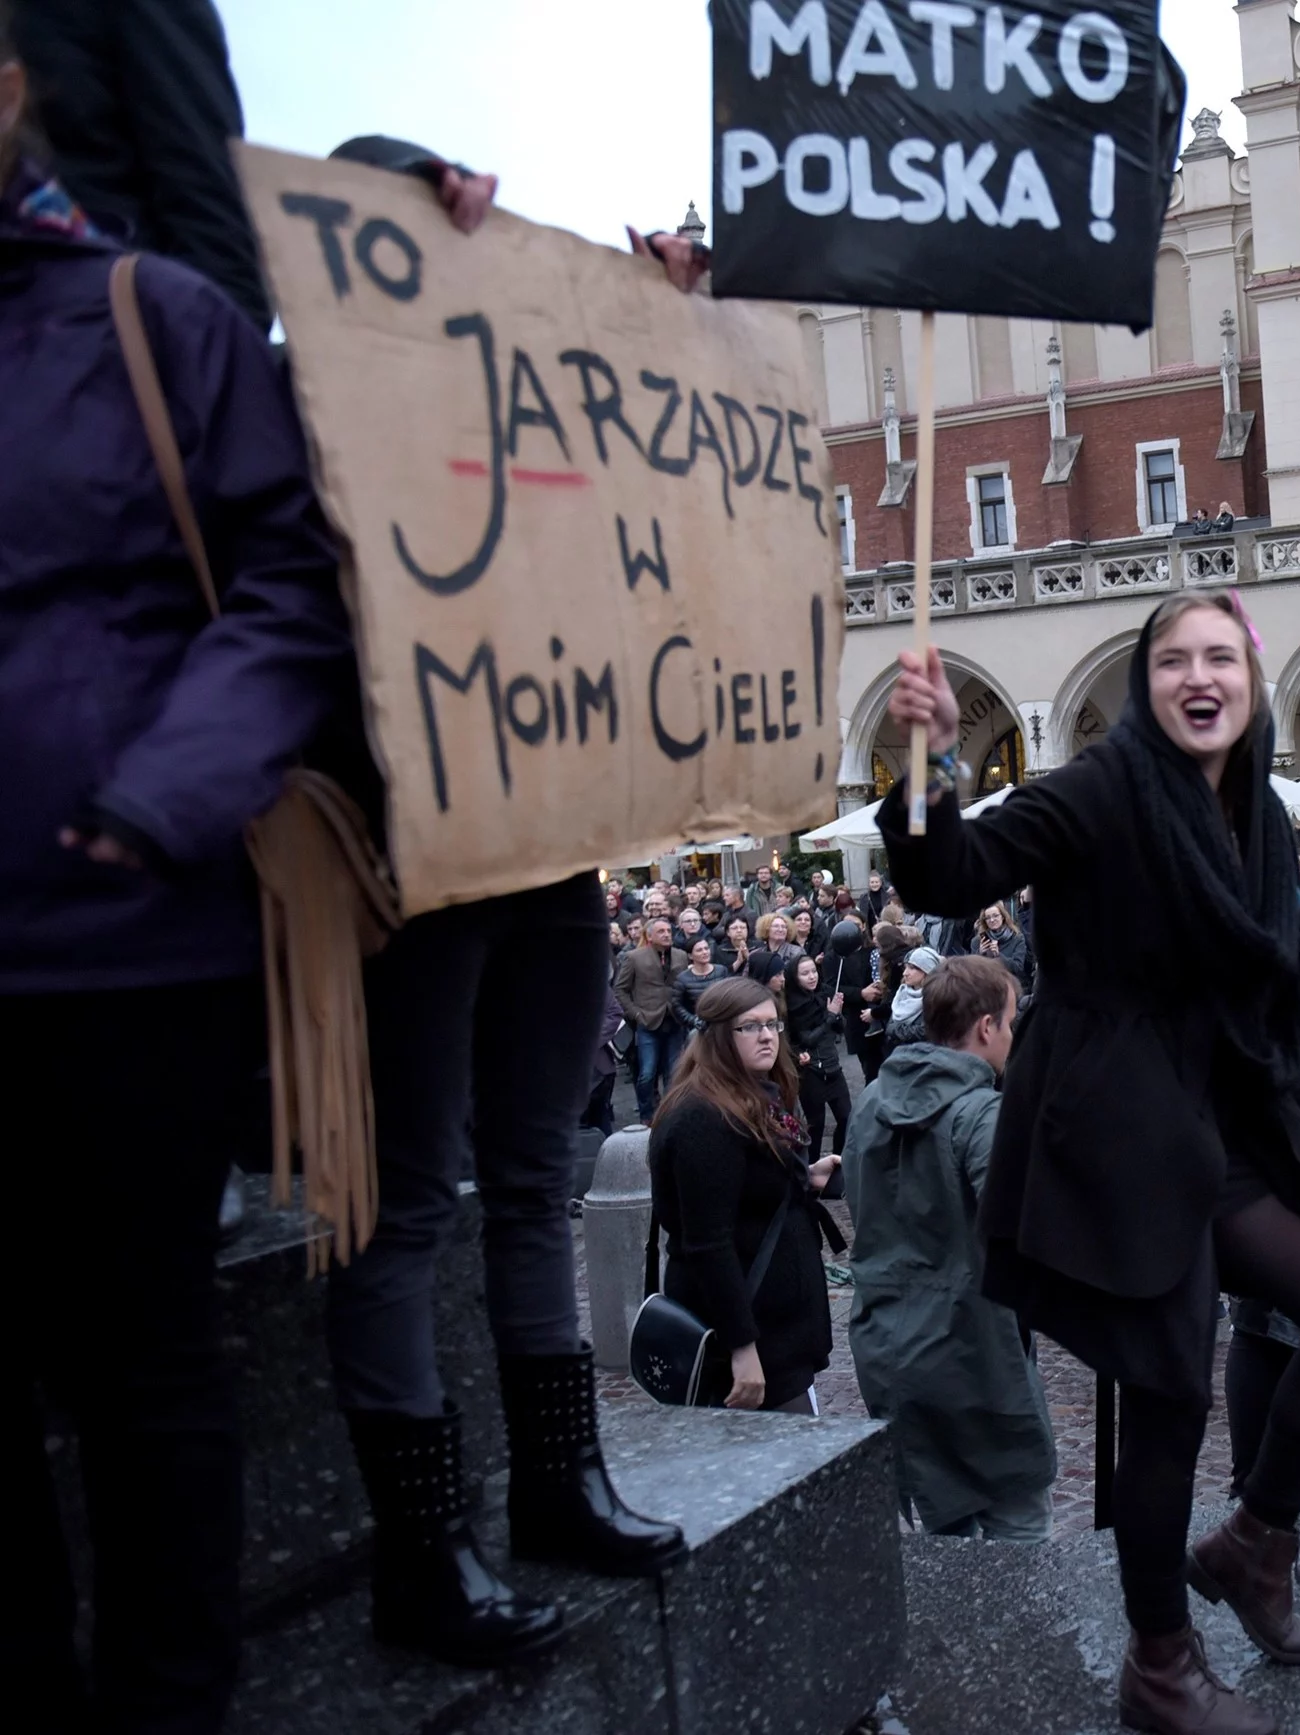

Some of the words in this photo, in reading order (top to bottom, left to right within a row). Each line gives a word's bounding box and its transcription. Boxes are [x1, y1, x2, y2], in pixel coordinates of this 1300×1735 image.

[749, 0, 1128, 103] MATKO
[722, 130, 1061, 231] POLSKA
[280, 191, 424, 303] TO
[391, 311, 828, 597] JARZĄDZĘ
